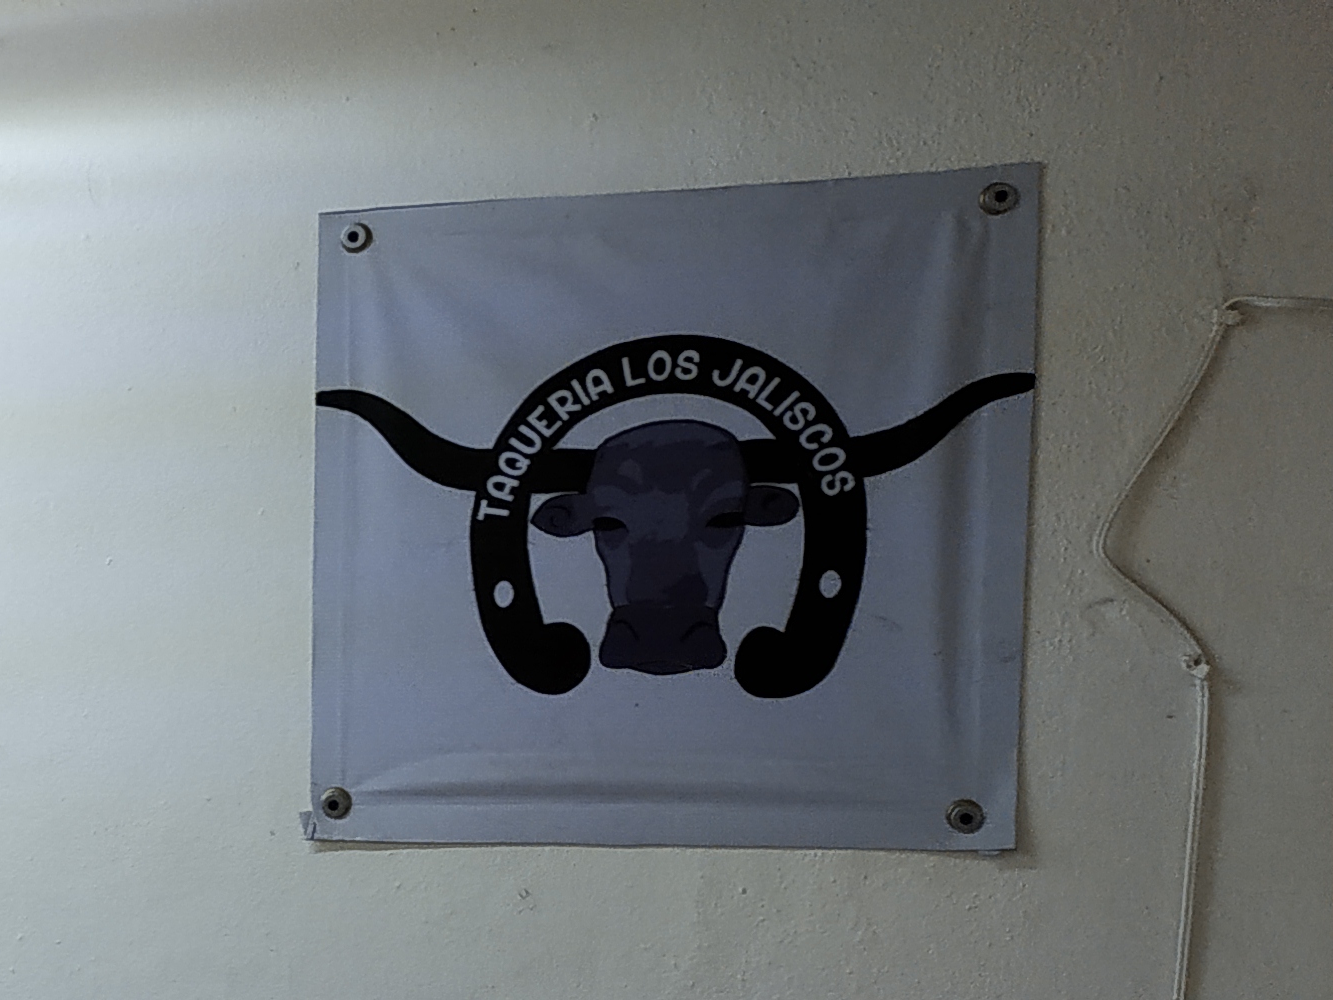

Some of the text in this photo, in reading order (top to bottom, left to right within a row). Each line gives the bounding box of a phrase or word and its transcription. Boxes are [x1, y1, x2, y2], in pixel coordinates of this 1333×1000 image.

[476, 349, 857, 521] TAQUERIA LOS JALISCOS
